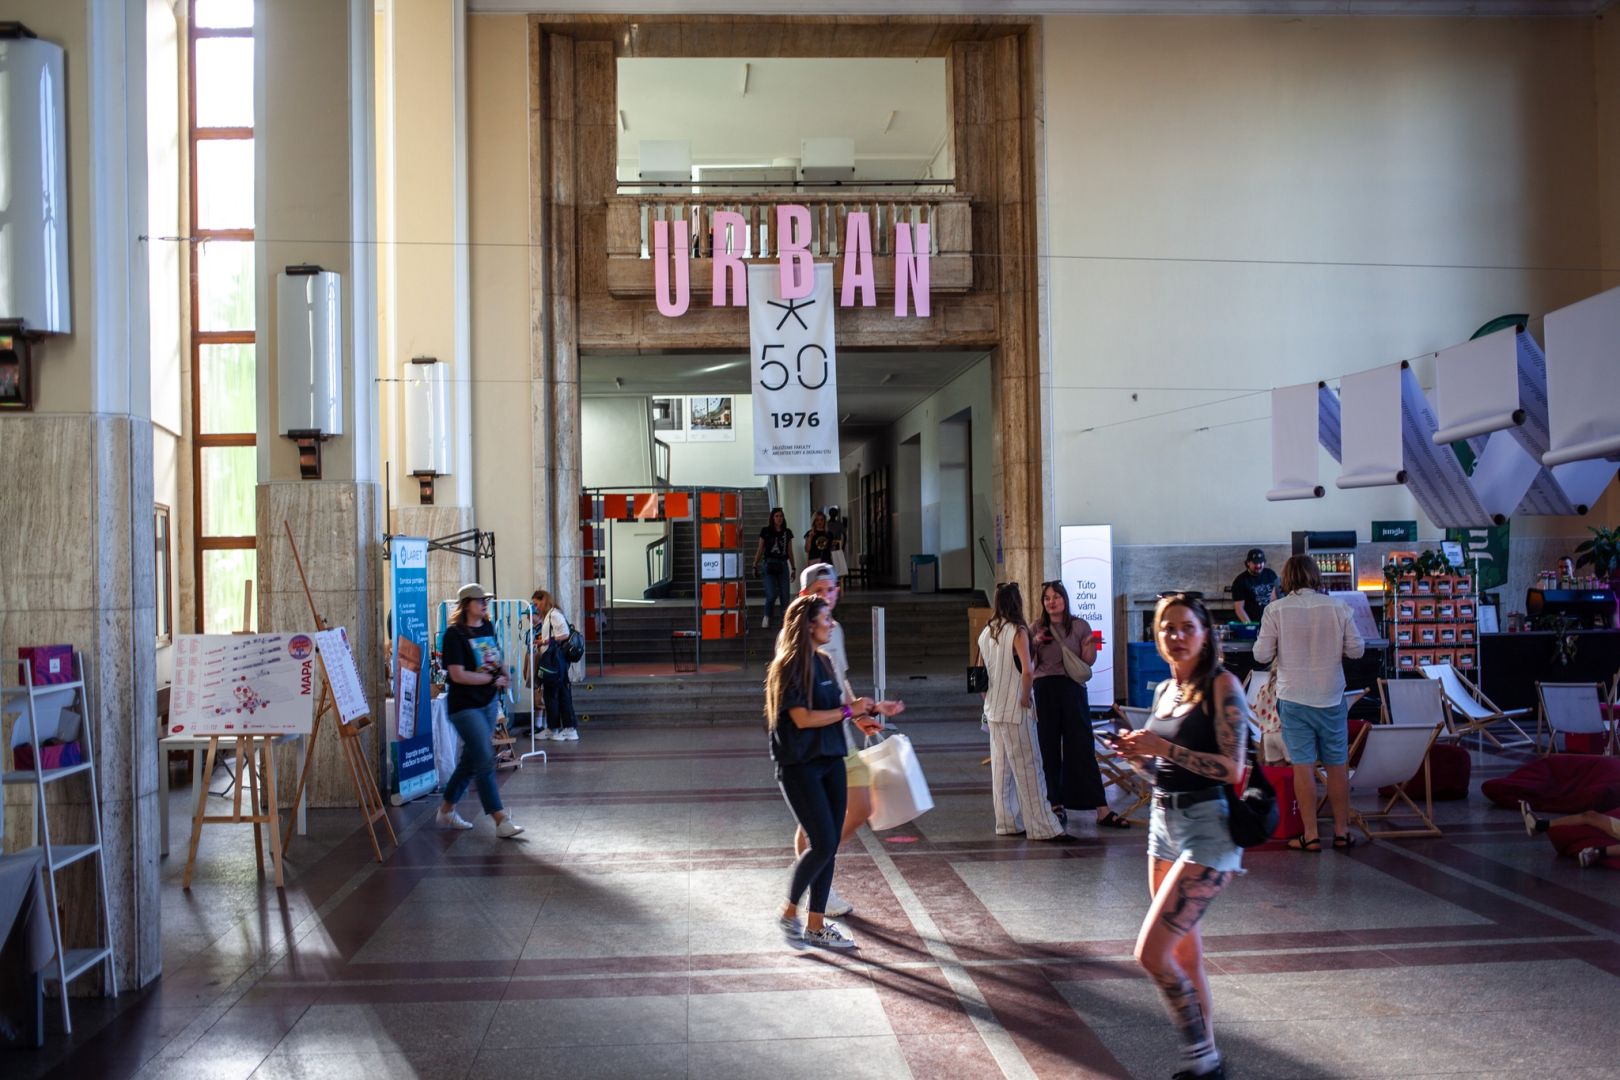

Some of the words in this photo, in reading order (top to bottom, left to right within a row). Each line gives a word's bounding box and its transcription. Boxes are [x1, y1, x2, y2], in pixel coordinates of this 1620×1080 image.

[654, 204, 930, 317] URBAN
[760, 344, 828, 391] 50
[771, 412, 820, 428] 1976
[1382, 527, 1405, 537] jungle
[1076, 580, 1096, 590] Túto
[1076, 590, 1097, 600] zónu
[1078, 601, 1096, 610] vám
[301, 660, 312, 695] MAPA
